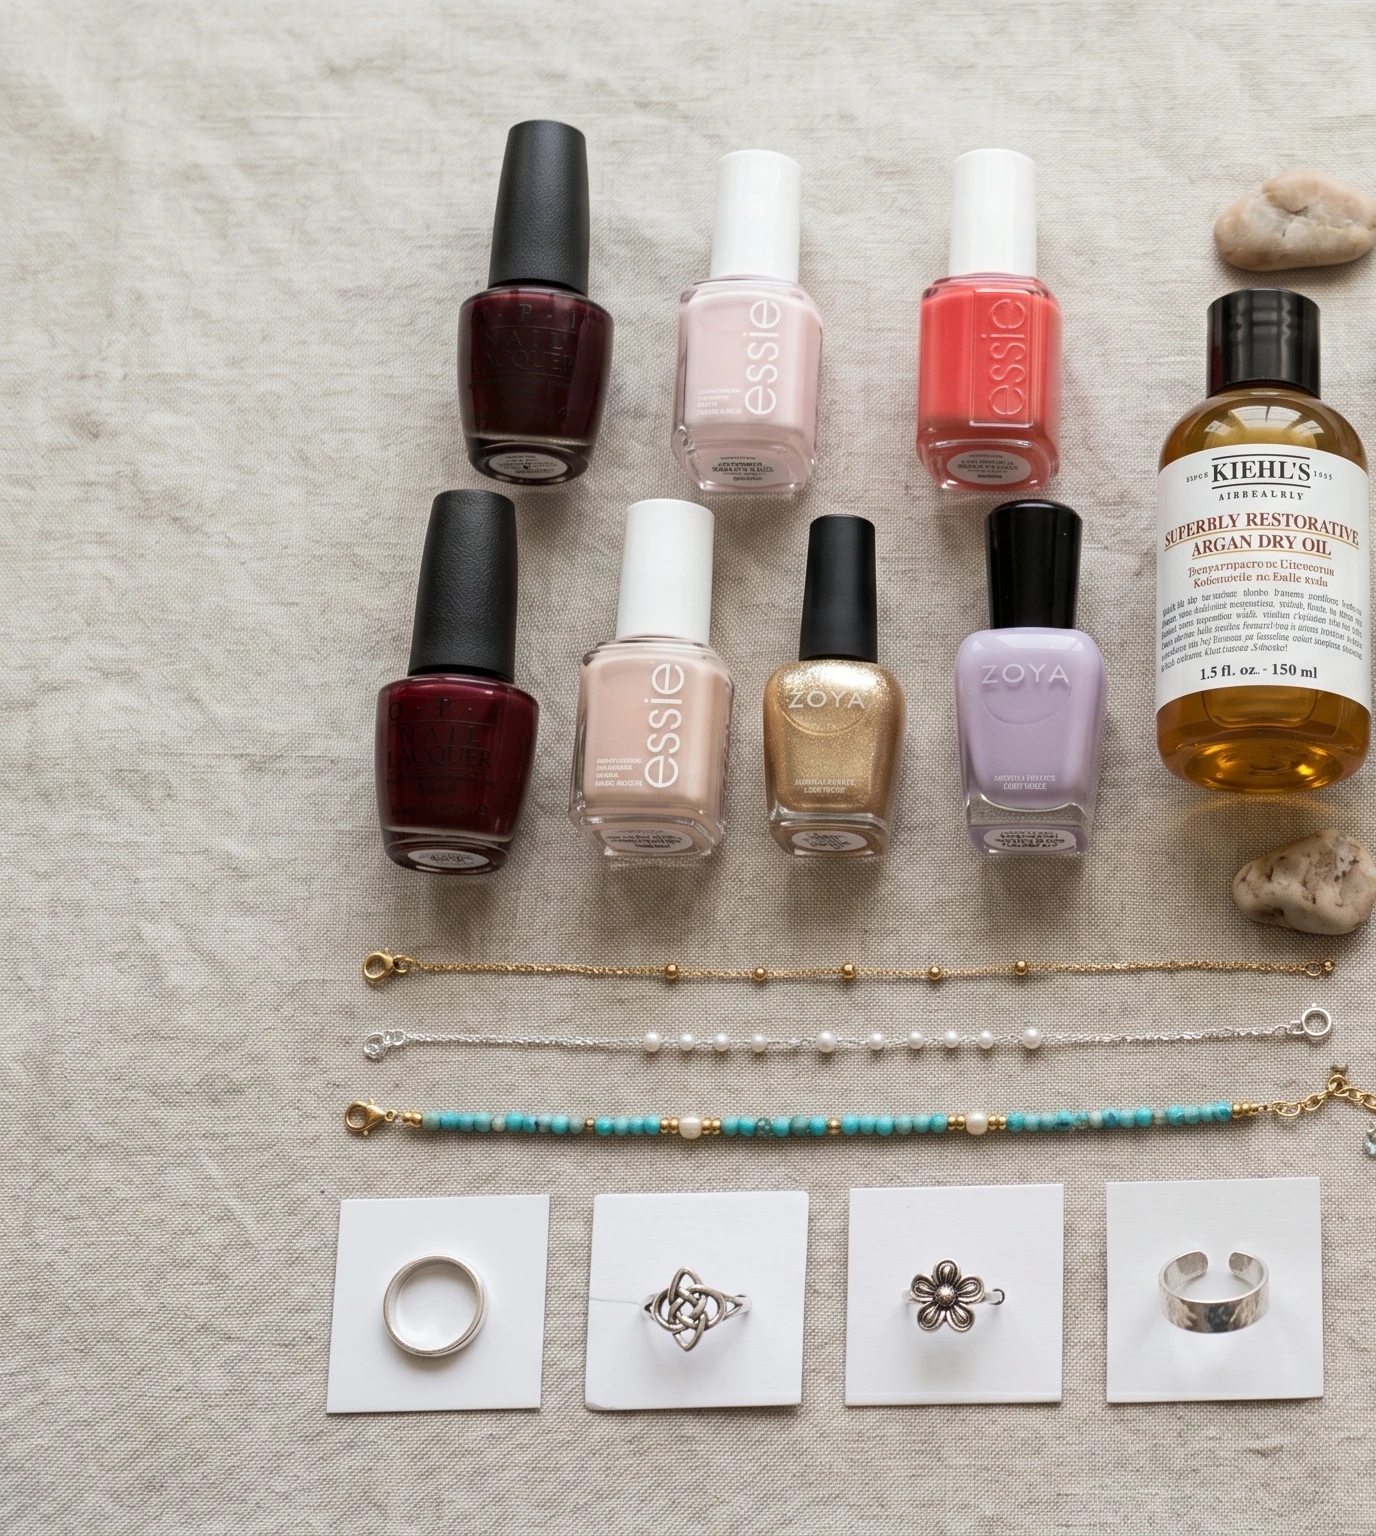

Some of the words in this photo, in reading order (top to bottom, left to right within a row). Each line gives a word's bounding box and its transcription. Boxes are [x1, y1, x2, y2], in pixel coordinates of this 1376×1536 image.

[742, 300, 781, 415] essie
[981, 298, 1027, 415] essie
[1211, 460, 1311, 483] KIEHL'S
[1245, 512, 1360, 546] RESTORATIVE
[1192, 534, 1252, 557] ARGAN
[1258, 534, 1298, 549] DRY
[1302, 537, 1332, 556] OIL
[981, 663, 1070, 685] ZOYA
[1200, 666, 1218, 681] 1.5
[1221, 664, 1236, 677] fl.
[1272, 663, 1297, 676] 150
[1300, 666, 1318, 679] ml
[787, 690, 866, 710] ZOYA
[400, 725, 481, 744] NAIL
[643, 662, 685, 788] essie
[388, 744, 493, 770] LACQUER
